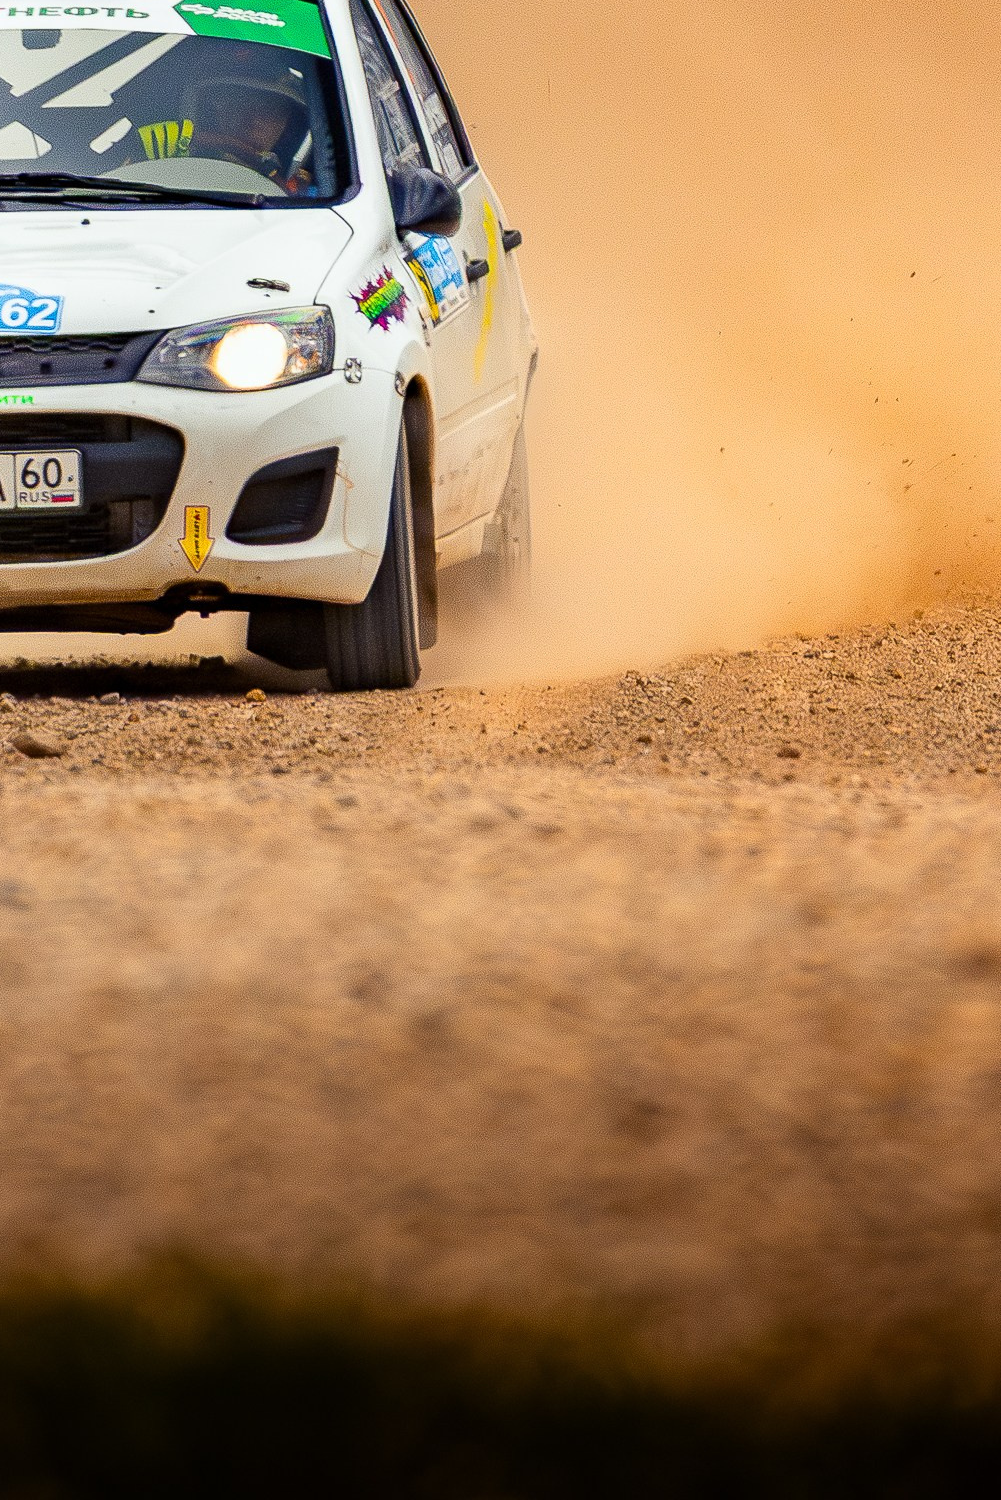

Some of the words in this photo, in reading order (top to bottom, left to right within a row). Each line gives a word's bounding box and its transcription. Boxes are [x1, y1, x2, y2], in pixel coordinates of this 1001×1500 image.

[0, 298, 59, 327] 62
[20, 457, 63, 488] 60
[19, 491, 50, 504] RUS
